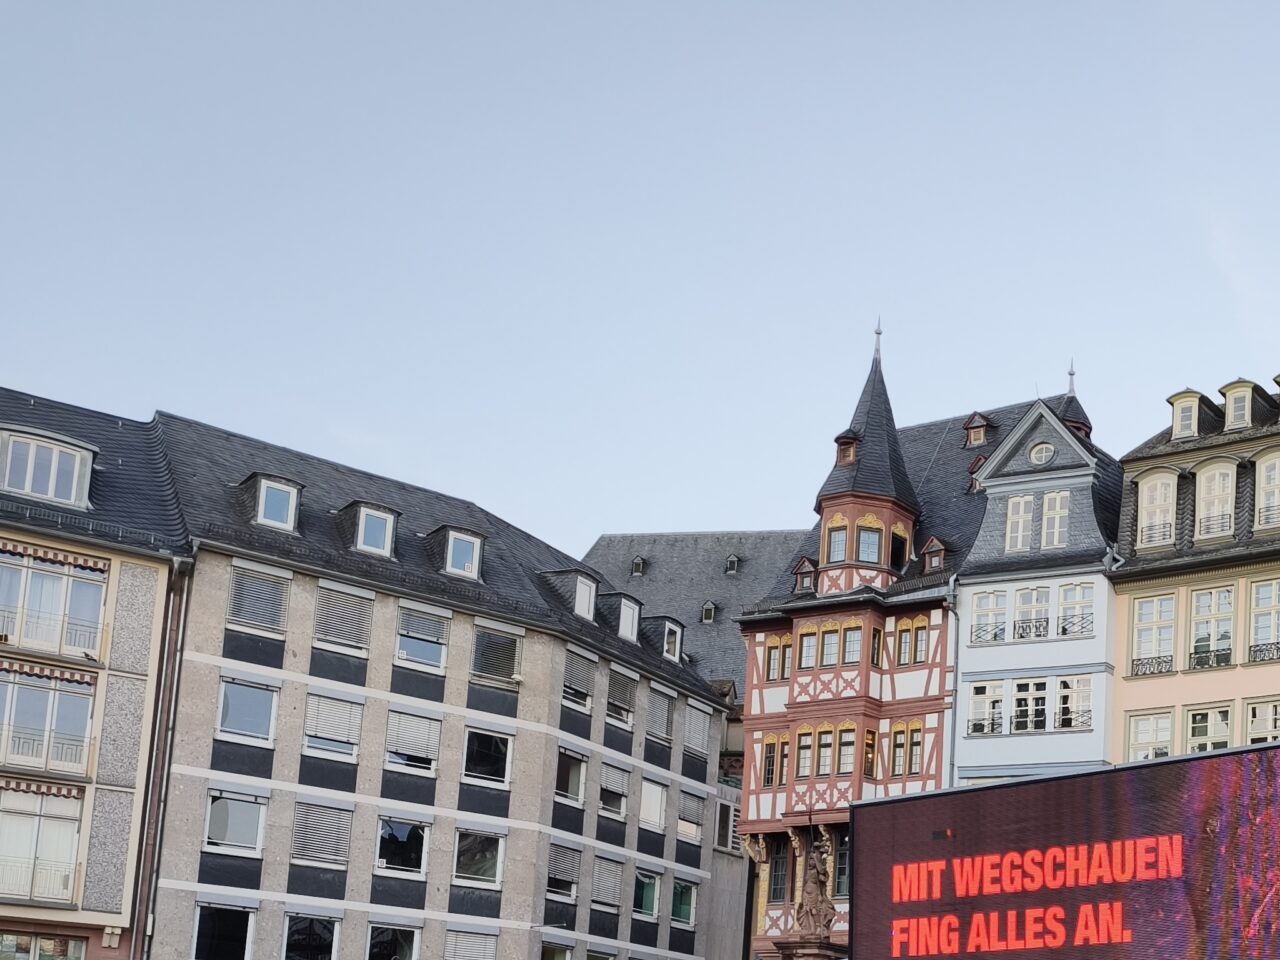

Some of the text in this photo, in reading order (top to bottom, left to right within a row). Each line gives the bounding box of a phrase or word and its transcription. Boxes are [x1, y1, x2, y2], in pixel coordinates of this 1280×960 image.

[892, 834, 1183, 904] MIT WEGSCHAUEN
[892, 901, 1133, 958] FING ALLES AN.
